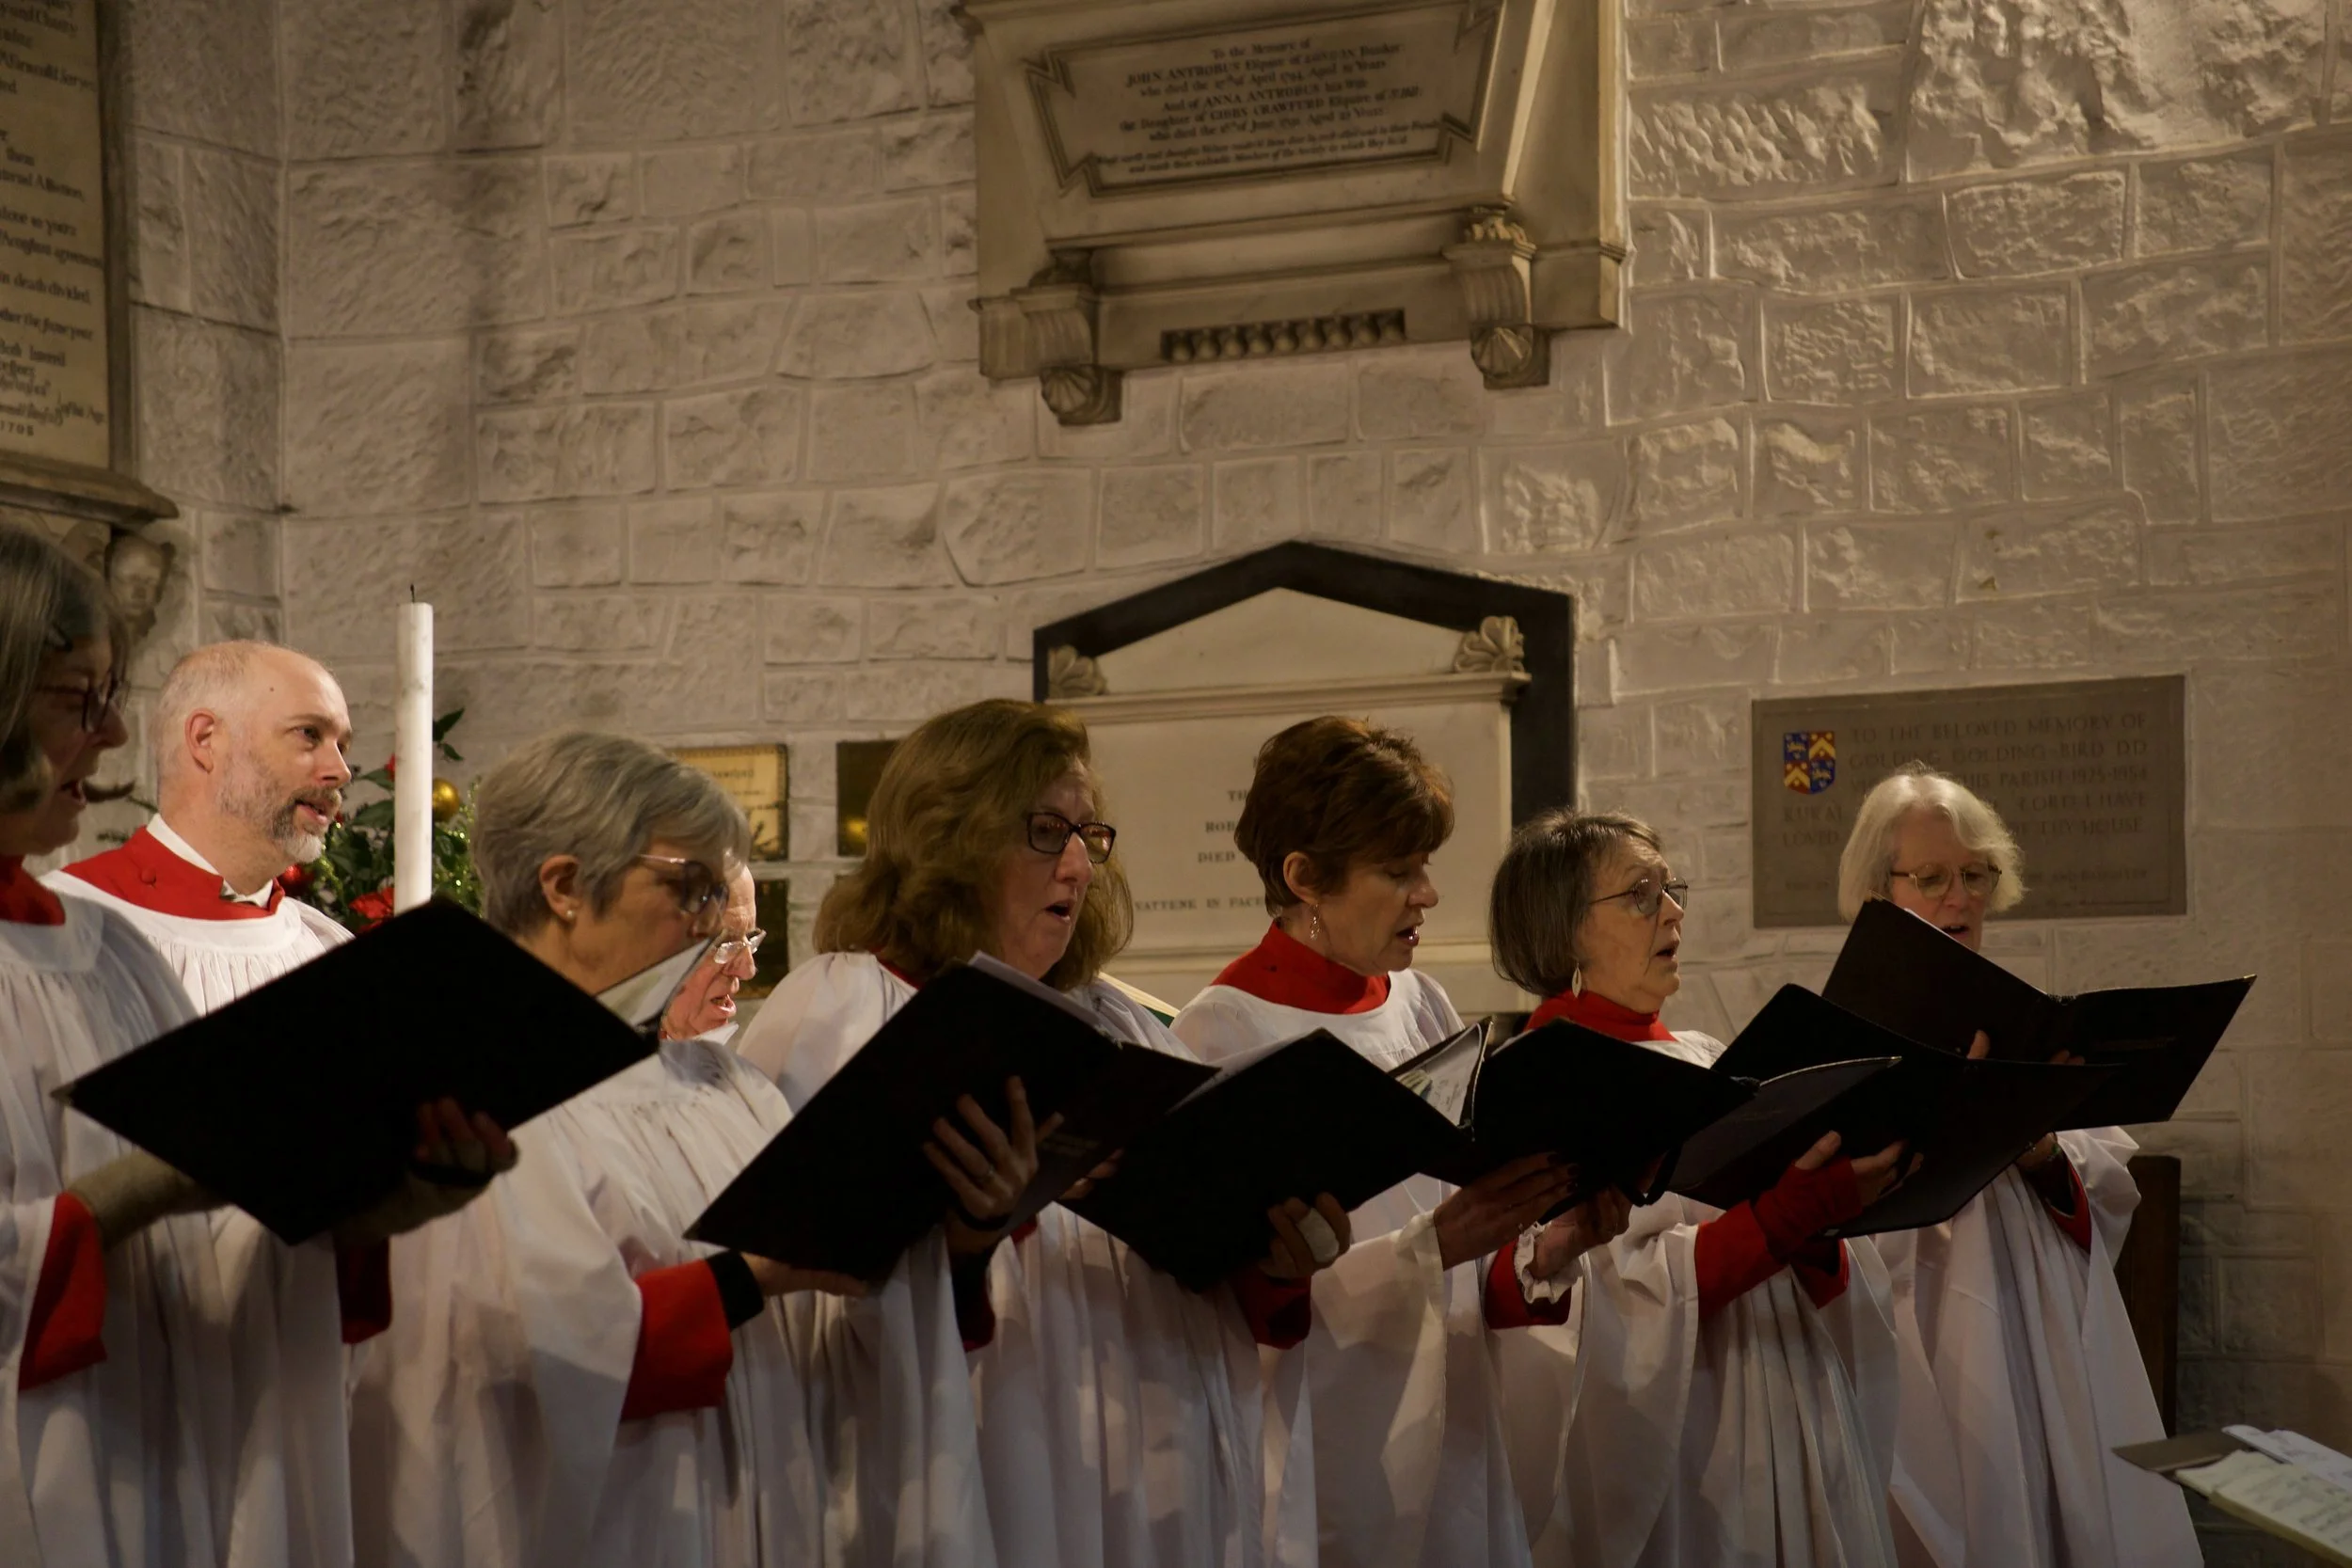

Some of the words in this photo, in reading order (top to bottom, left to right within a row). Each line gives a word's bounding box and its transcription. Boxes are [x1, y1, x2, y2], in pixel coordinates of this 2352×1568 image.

[1230, 46, 1245, 56] the
[1251, 42, 1295, 55] Memory
[1300, 38, 1311, 49] of
[1126, 71, 1162, 87] JOHN
[1168, 62, 1240, 79] ANTROBUS
[1251, 71, 1277, 87] April
[1204, 94, 1242, 108] ANNA
[1247, 83, 1320, 103] ANTROBUS
[1851, 728, 1876, 743] TO
[1889, 726, 1921, 741] THE
[1932, 719, 2016, 739] BELOVED
[2027, 714, 2113, 736] MEMORY
[2121, 712, 2147, 729] OF
[2000, 768, 2063, 788] PARISH
[2099, 791, 2147, 809] HAVE
[2081, 816, 2144, 836] HOUSE
[1198, 851, 1235, 863] DIED
[1205, 897, 1221, 910] IN
